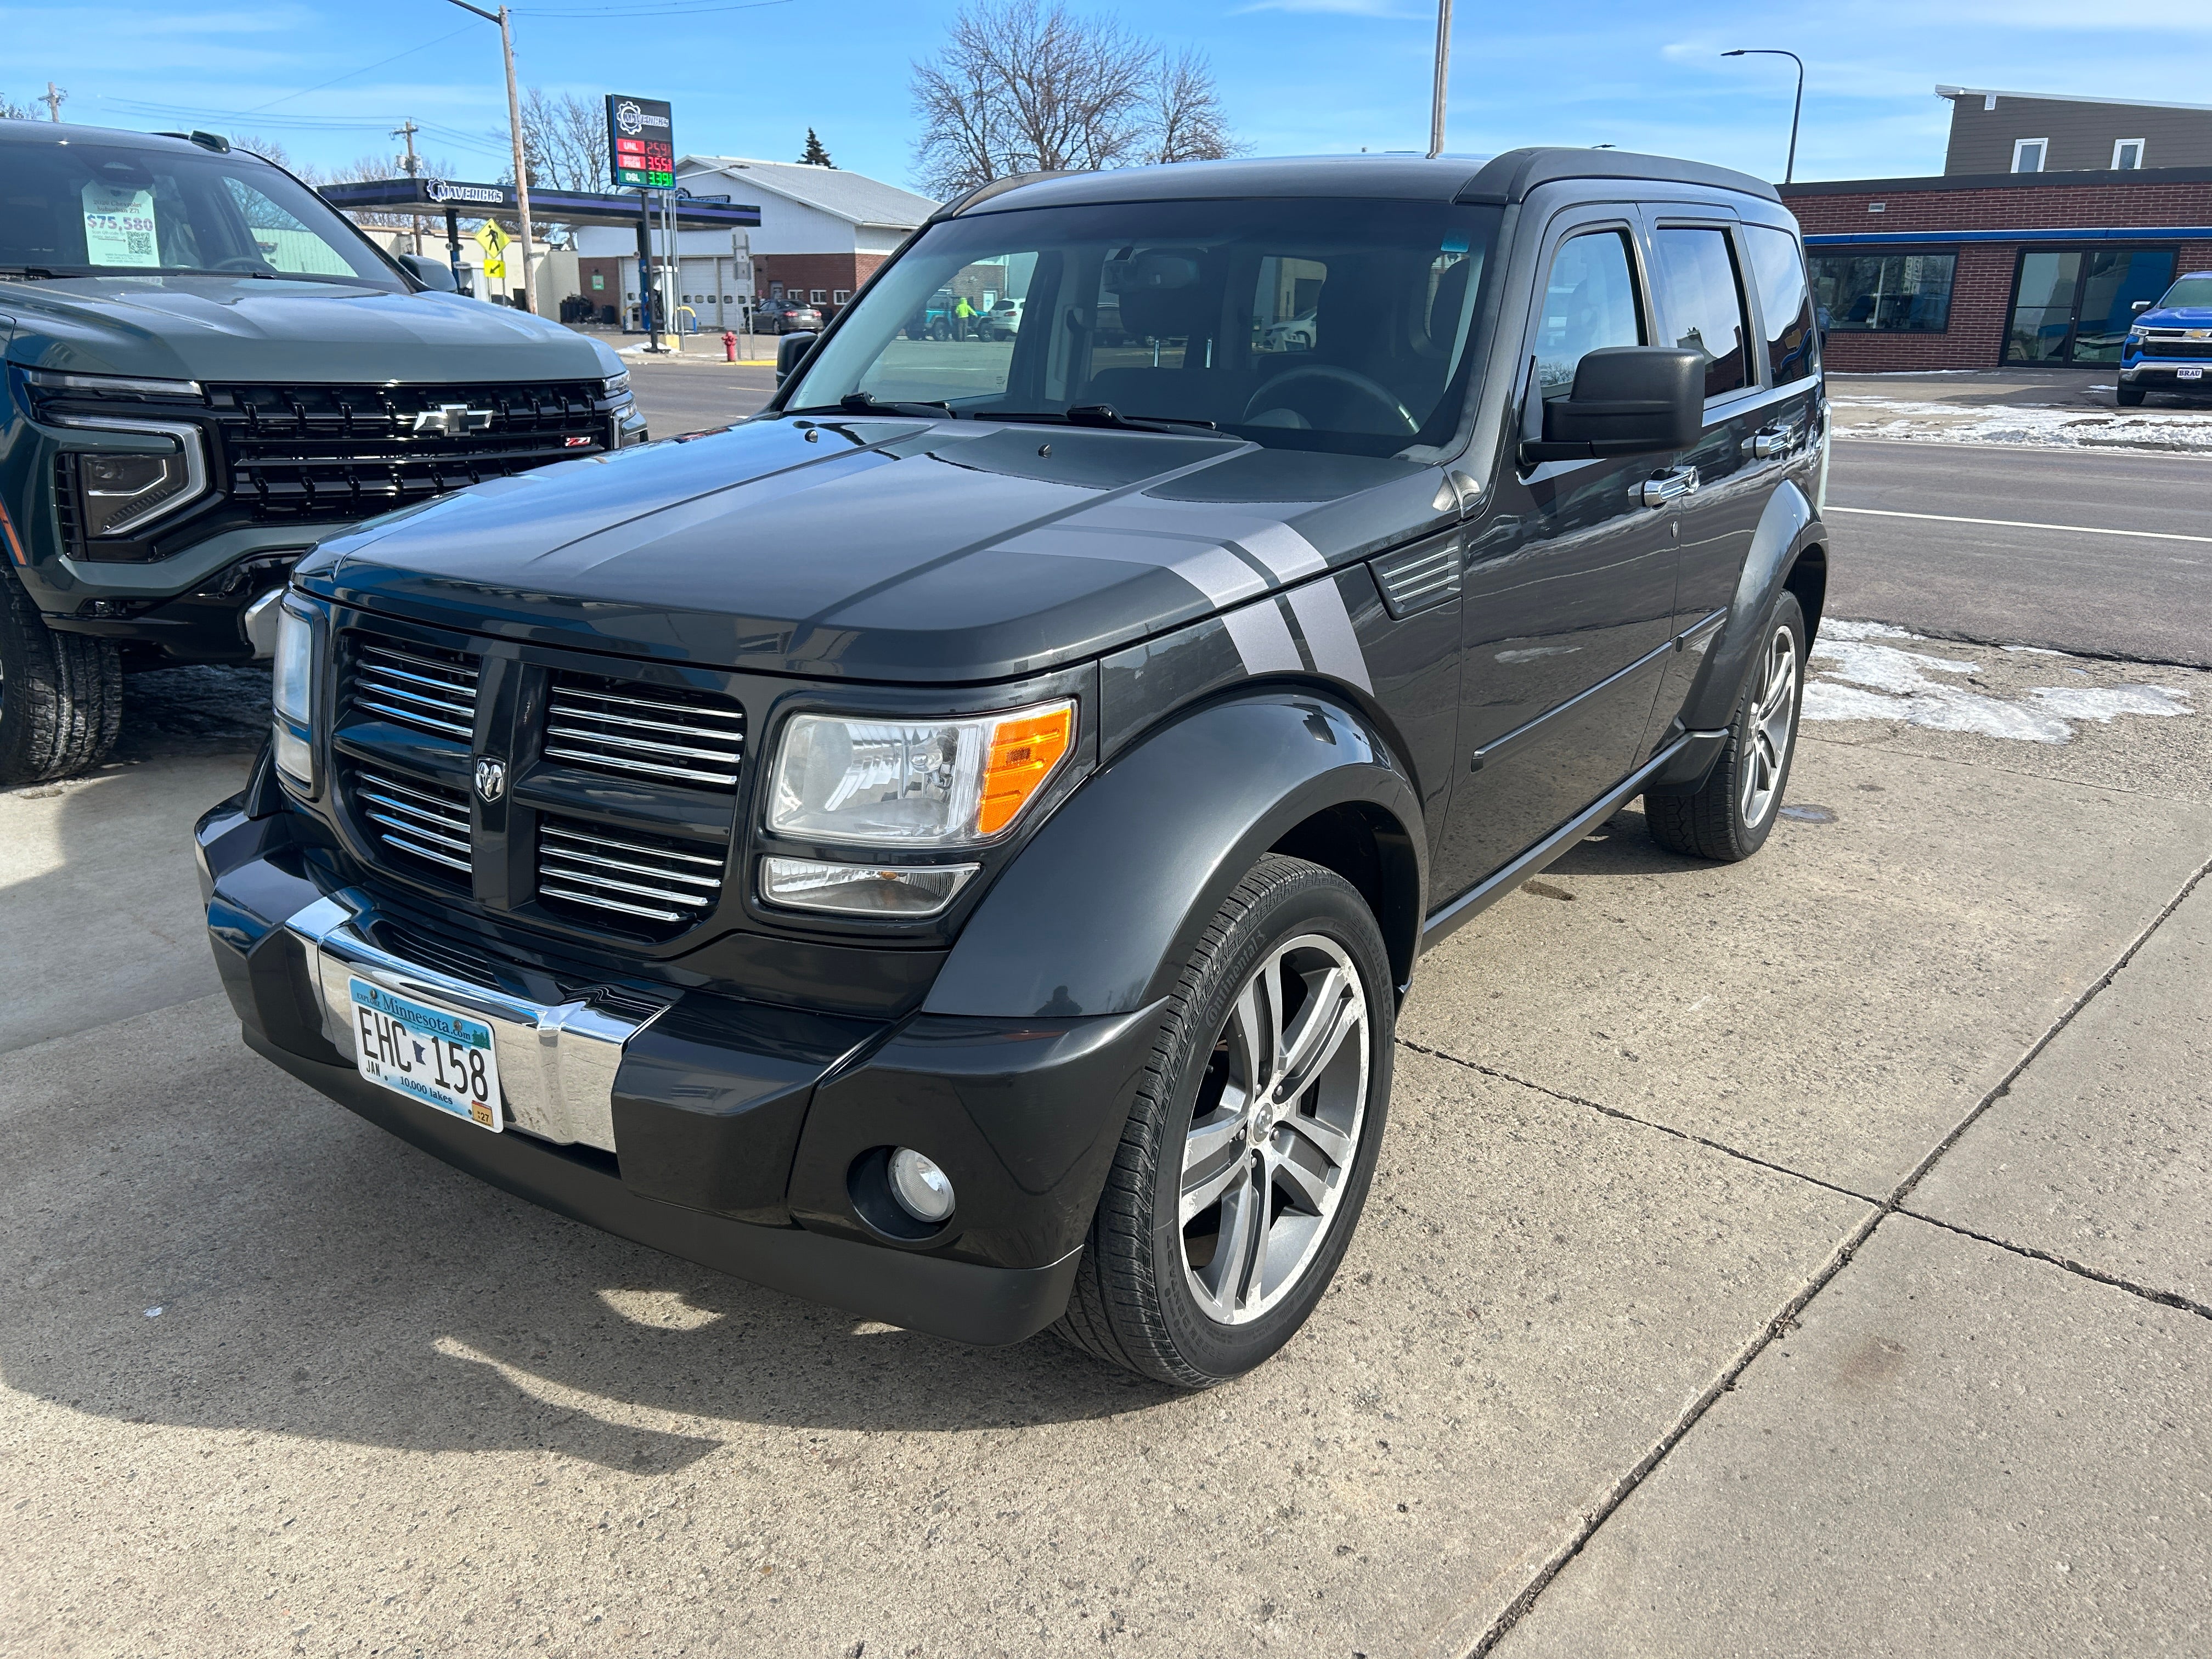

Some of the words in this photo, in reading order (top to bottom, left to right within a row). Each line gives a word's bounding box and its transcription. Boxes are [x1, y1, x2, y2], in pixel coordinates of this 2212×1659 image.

[623, 141, 639, 151] UNL
[625, 172, 641, 183] DSL
[87, 214, 154, 232] $75,580
[1205, 935, 1260, 1029] Continental
[358, 1005, 412, 1073] EHC
[432, 1036, 488, 1102] 158
[366, 1060, 381, 1077] JAN
[399, 1076, 427, 1095] 10,000
[430, 1088, 453, 1105] lakes
